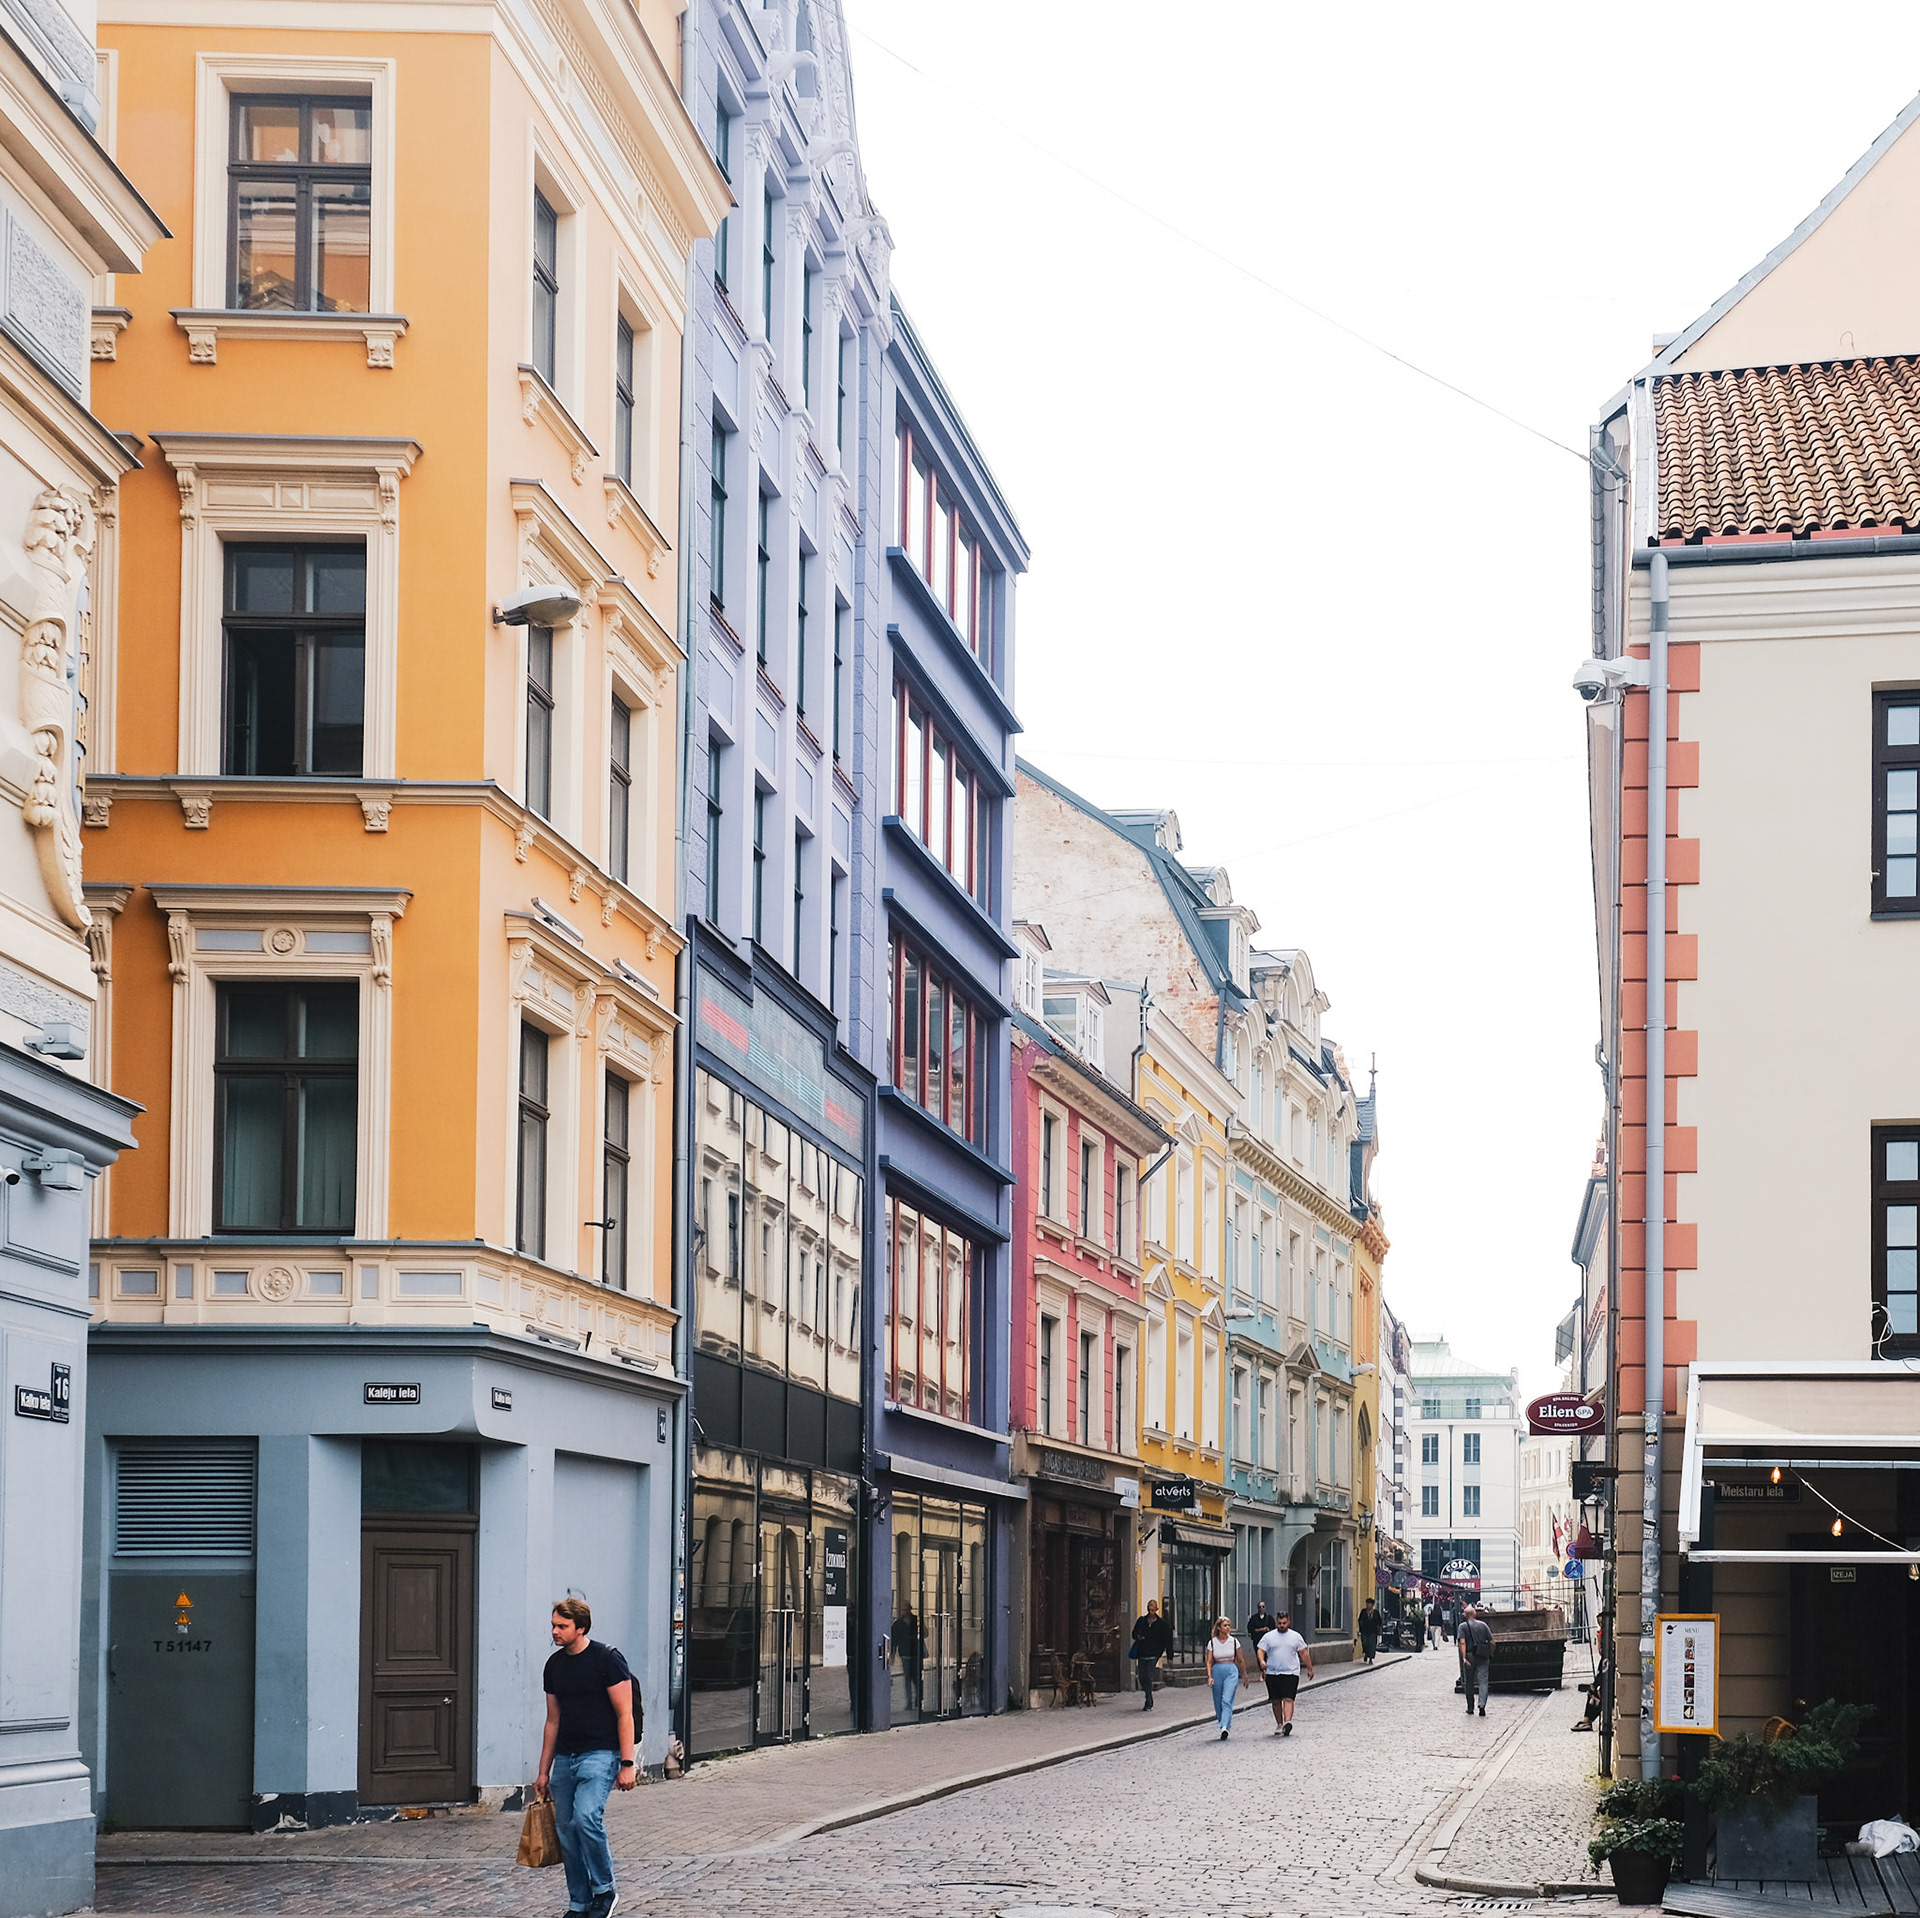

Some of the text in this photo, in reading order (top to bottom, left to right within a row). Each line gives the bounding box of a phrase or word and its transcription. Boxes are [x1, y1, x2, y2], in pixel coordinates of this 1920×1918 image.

[55, 1377, 69, 1400] 16
[399, 1387, 416, 1399] iela
[1539, 1404, 1575, 1418] Elien
[1721, 1486, 1784, 1497] Meistaru iela
[1446, 1560, 1473, 1572] COSTA
